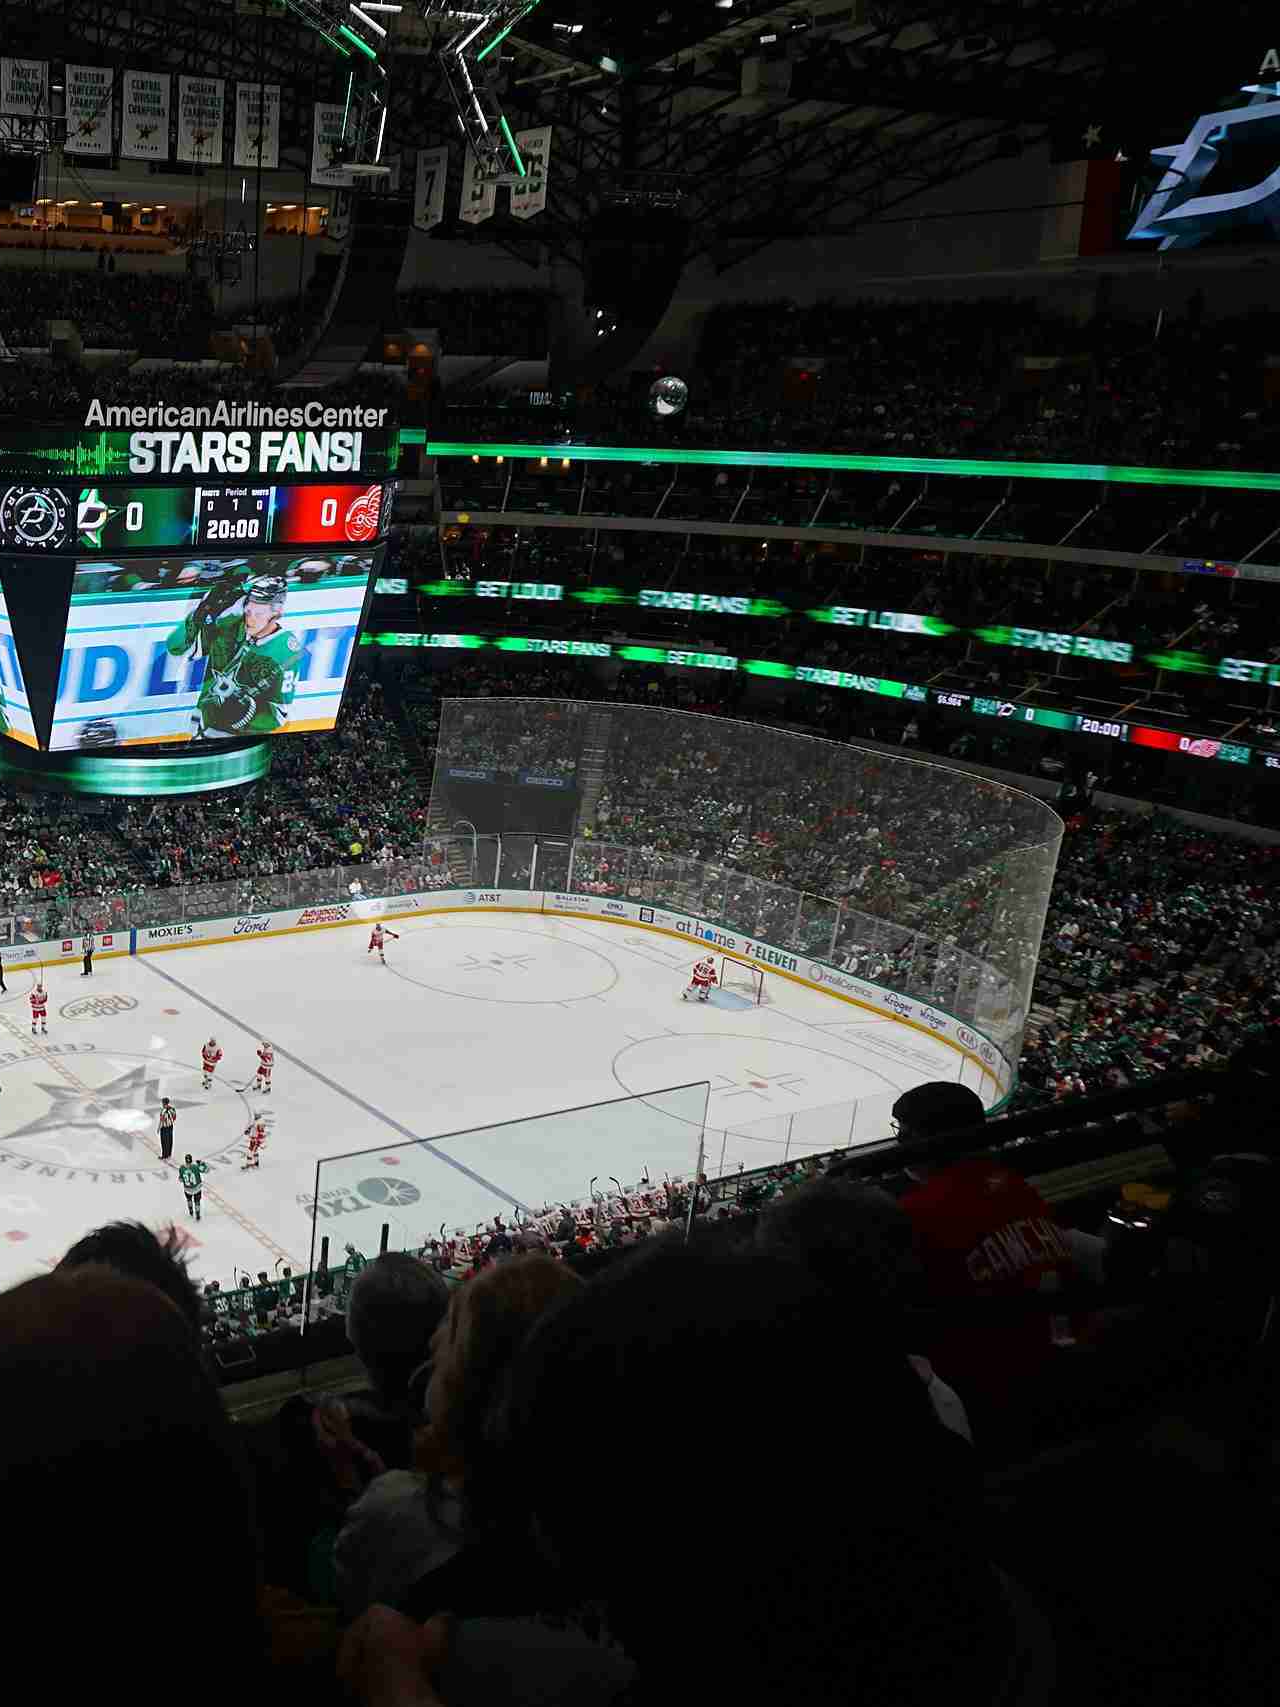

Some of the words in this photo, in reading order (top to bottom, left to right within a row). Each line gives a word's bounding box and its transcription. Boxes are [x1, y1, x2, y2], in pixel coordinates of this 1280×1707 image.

[74, 72, 104, 83] WESTERN
[131, 80, 161, 92] CENTRAL
[133, 93, 161, 104] DIVISION
[188, 84, 216, 95] WESTERN
[128, 104, 165, 117] CHAMPIONS
[182, 95, 223, 109] CONFERENCE
[183, 108, 220, 119] CHAMPIONS
[84, 399, 387, 428] AmericanAirlinesCenter
[128, 432, 251, 473] STARS
[258, 432, 362, 473] FANS!
[225, 487, 247, 497] Period
[207, 501, 214, 511] 0
[232, 499, 238, 510] 1
[256, 501, 263, 511] 0
[320, 499, 337, 527] 0
[125, 502, 143, 531] 0
[207, 519, 259, 539] 20:00
[476, 581, 509, 598] GET
[638, 589, 695, 610] STARS
[832, 607, 869, 626] GET
[396, 634, 421, 646] GET
[527, 638, 568, 655] STARS
[571, 641, 611, 657] FANS!
[1011, 627, 1072, 655] STARS
[667, 650, 693, 665] GET
[795, 666, 840, 686] STARS
[1219, 657, 1267, 682] GET
[1025, 708, 1034, 721] 0
[1081, 719, 1121, 738] 20:00
[1179, 737, 1188, 751] 0
[479, 894, 501, 903] AT&T
[148, 925, 193, 939] MOXIE'S
[234, 916, 269, 934] Ford
[676, 921, 691, 934] at
[694, 921, 736, 949] home
[69, 995, 130, 1017] Pepper
[883, 992, 913, 1014] Kroger
[920, 1007, 947, 1029] Kroger
[304, 1196, 372, 1218] TXU
